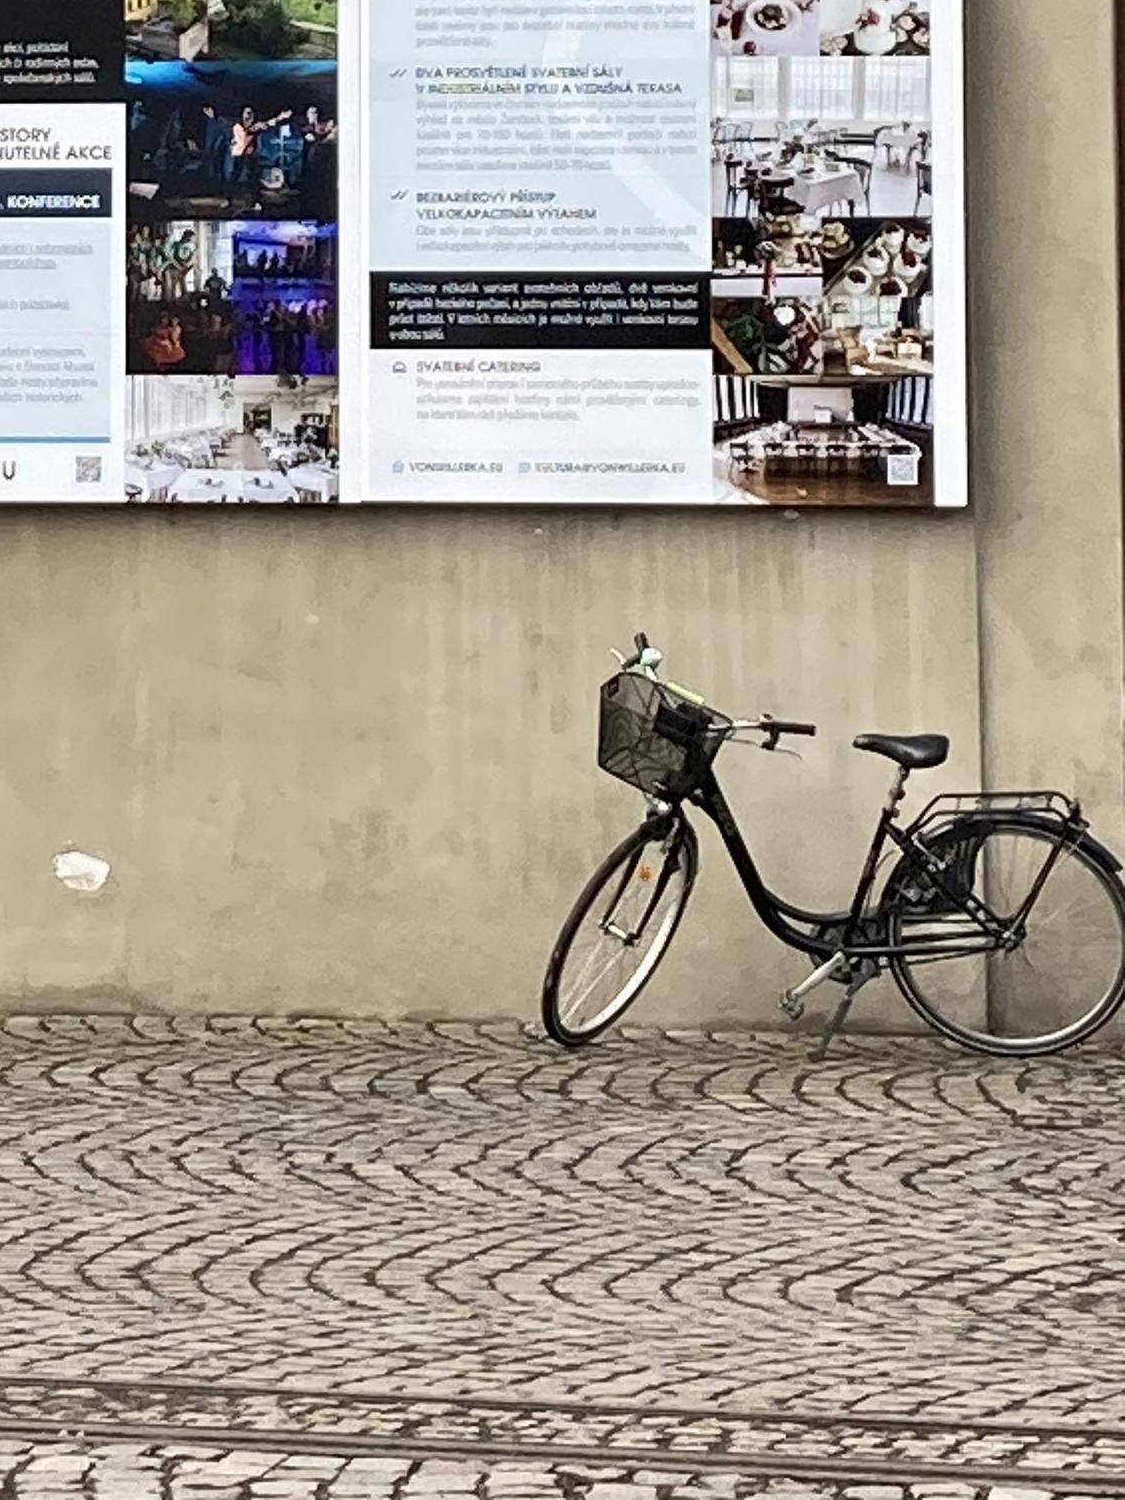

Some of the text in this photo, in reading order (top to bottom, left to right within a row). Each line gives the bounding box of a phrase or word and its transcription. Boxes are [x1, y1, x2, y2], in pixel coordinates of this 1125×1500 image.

[415, 66, 443, 80] DVA
[531, 63, 590, 79] SVATEBNÍ
[592, 62, 623, 79] SÁLY
[635, 83, 683, 95] TERASA
[65, 145, 112, 161] AKCE
[6, 194, 101, 209] KONFERENCE
